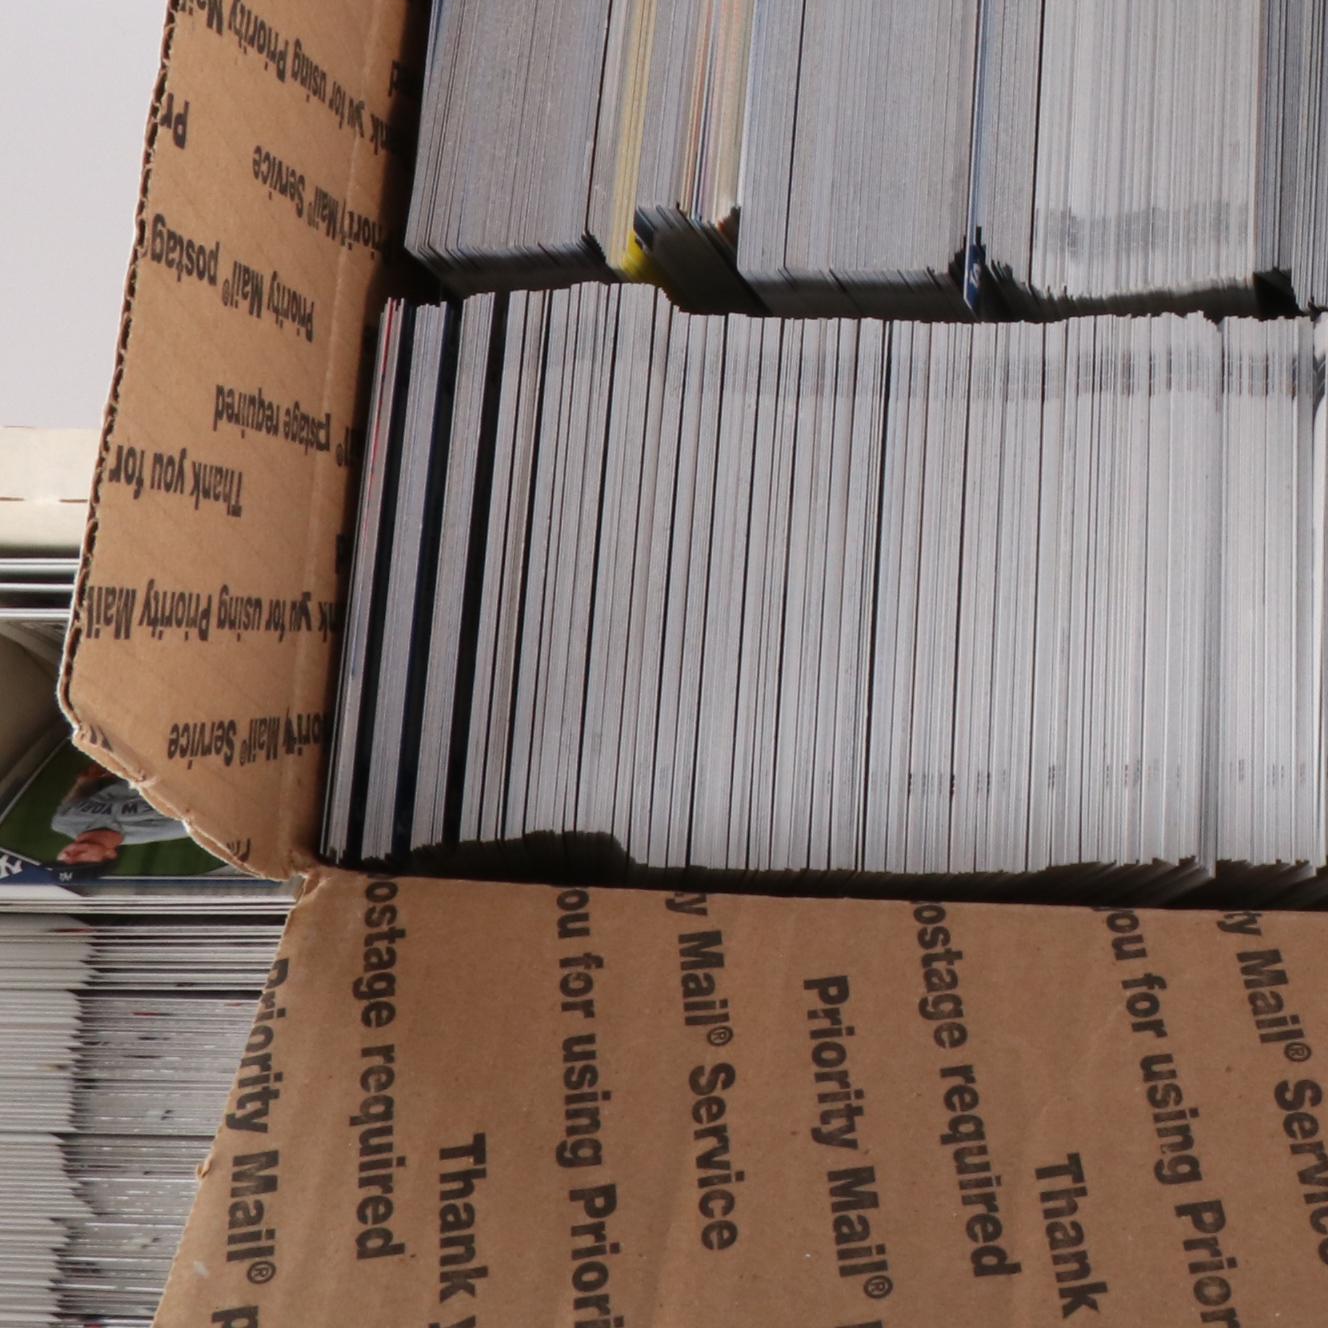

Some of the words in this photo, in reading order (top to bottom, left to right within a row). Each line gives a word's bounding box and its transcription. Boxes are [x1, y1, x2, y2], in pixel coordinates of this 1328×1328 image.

[290, 35, 328, 106] using
[252, 145, 306, 219] Service
[147, 213, 220, 286] postag
[266, 270, 315, 343] Priority
[213, 384, 279, 439] required
[108, 442, 145, 501] for
[150, 446, 187, 497] you
[190, 461, 244, 518] Thank
[138, 578, 211, 641] Priority
[217, 584, 263, 642] using
[167, 719, 236, 769] Service
[351, 873, 406, 1030] ostage
[558, 953, 604, 1019] for
[677, 930, 734, 1047] Mail®
[911, 900, 968, 1050] ostage
[1121, 973, 1167, 1038] for
[1236, 948, 1312, 1063] Mail®
[554, 1033, 611, 1168] using
[803, 974, 865, 1150] Priority
[1139, 1053, 1202, 1185] using
[349, 1043, 406, 1260] required
[688, 1063, 745, 1251] Service
[939, 1064, 1022, 1278] required
[226, 1150, 279, 1286] Mail®
[438, 1132, 488, 1303] Thank
[827, 1166, 893, 1300] Mail®
[1035, 1152, 1108, 1318] Thank
